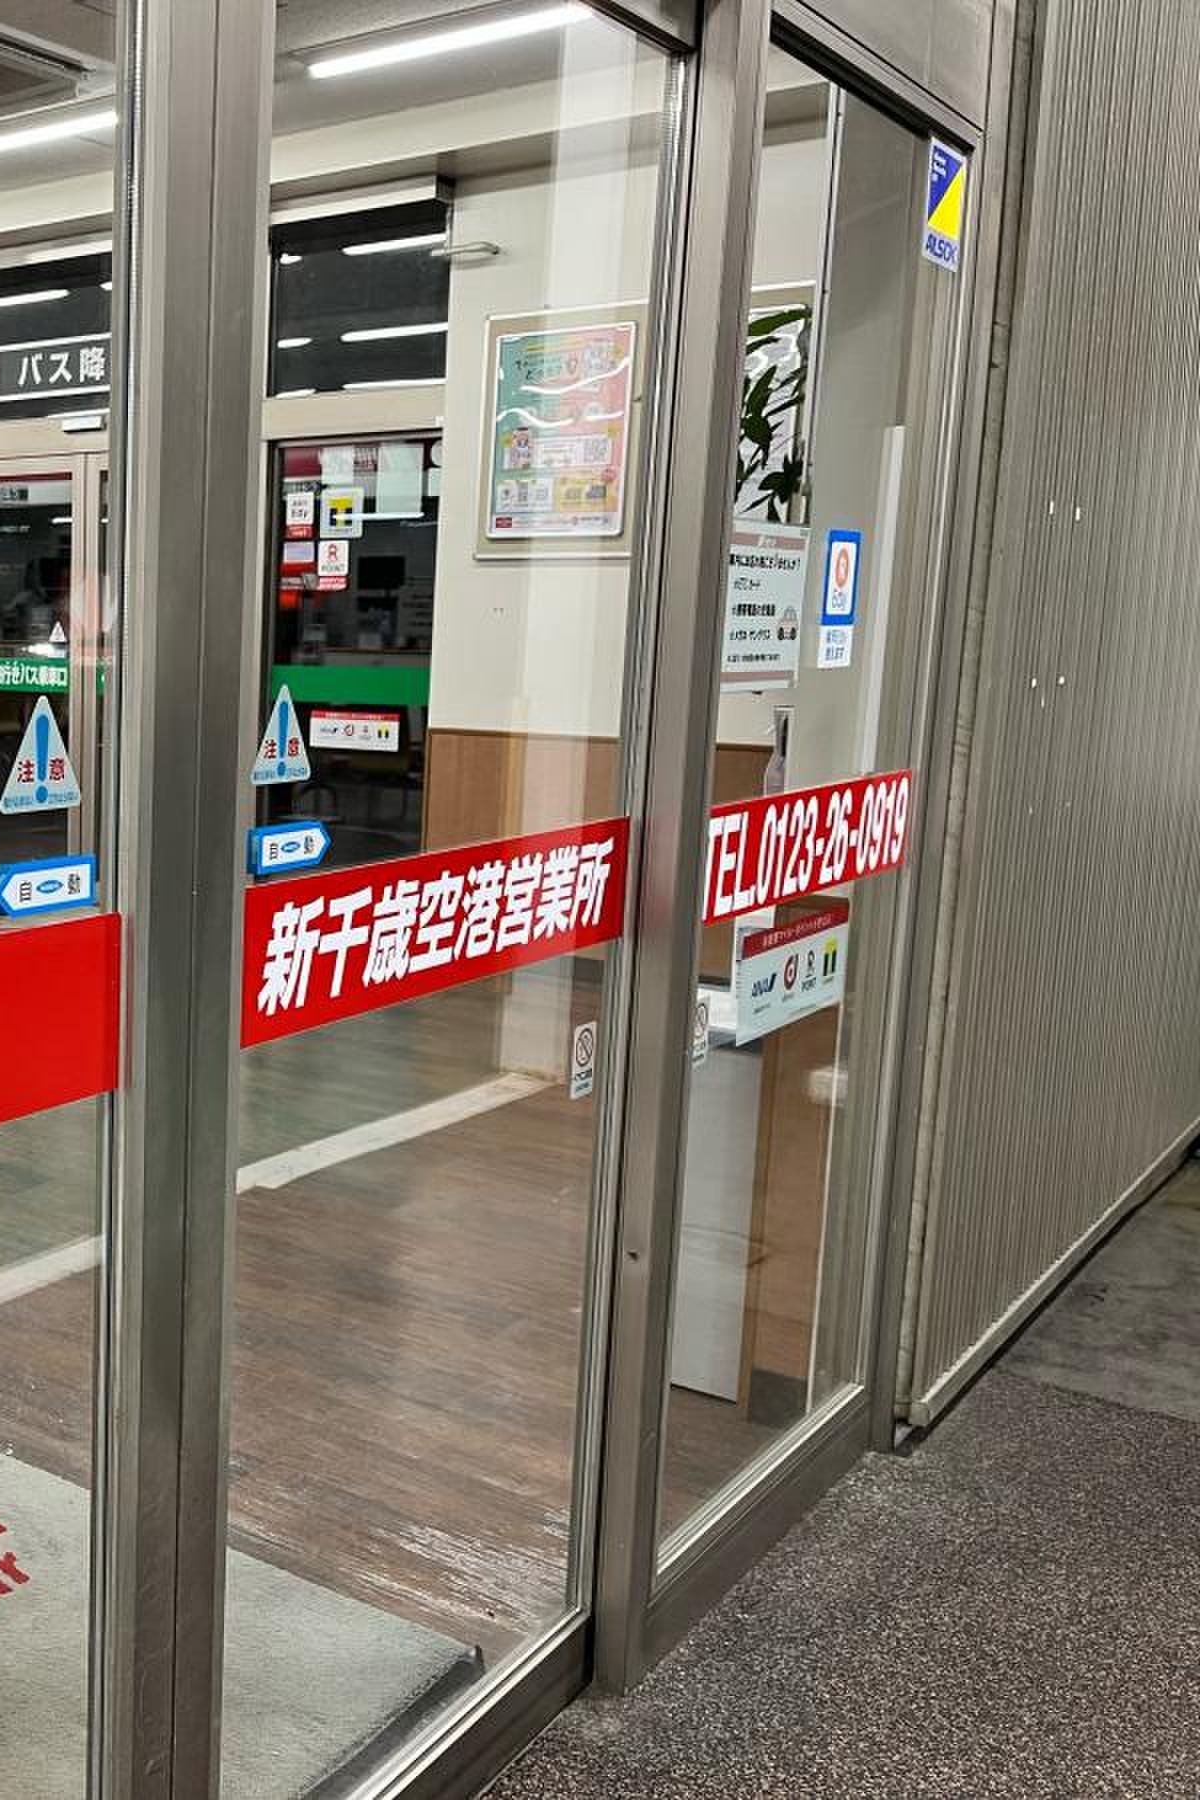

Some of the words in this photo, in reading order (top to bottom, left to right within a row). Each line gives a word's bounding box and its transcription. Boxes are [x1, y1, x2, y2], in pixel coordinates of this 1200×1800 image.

[18, 346, 106, 386] バス降
[17, 758, 64, 783] 注意
[703, 777, 909, 921] TEL.0123-26-0919
[258, 838, 614, 1016] 新千歳空港営業所
